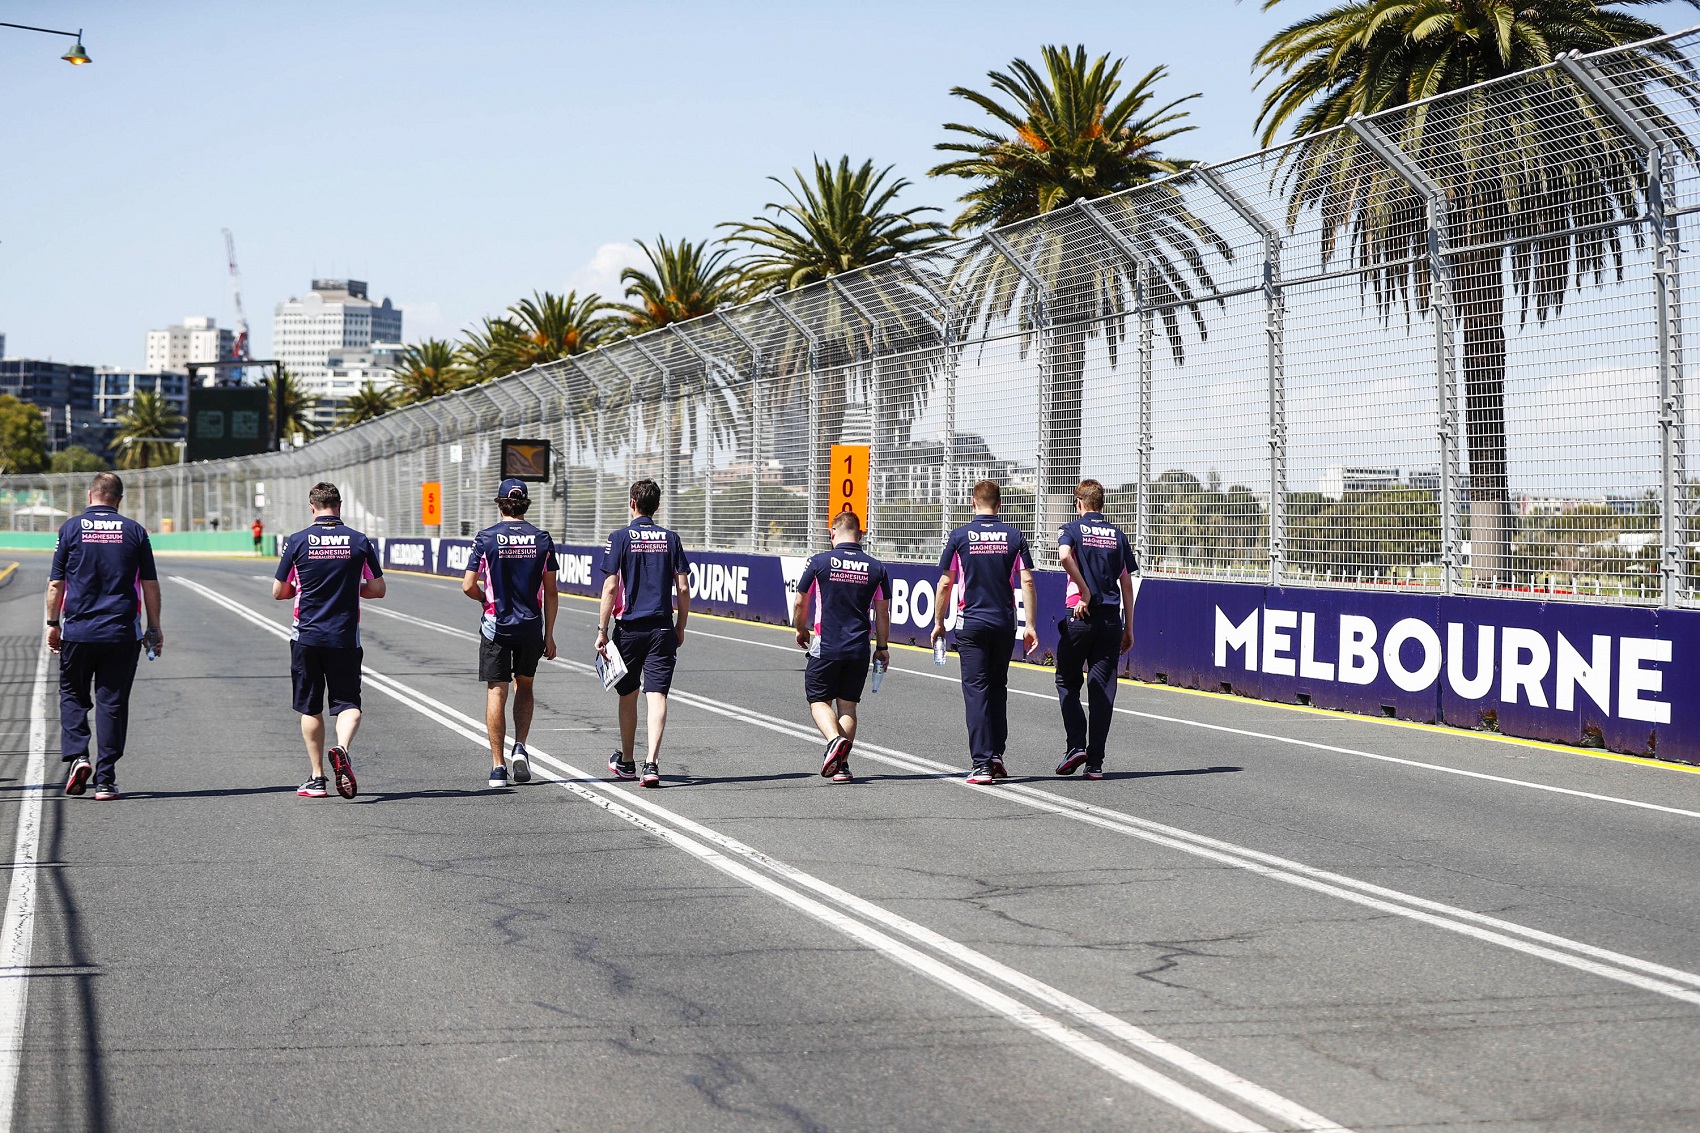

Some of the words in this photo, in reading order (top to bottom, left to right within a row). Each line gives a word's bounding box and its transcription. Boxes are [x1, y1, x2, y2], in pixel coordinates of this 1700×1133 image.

[94, 520, 123, 530] BWT
[640, 531, 667, 540] BWT
[980, 531, 1007, 541] BWT
[1091, 526, 1116, 537] BWT
[321, 535, 350, 546] BWT
[508, 535, 536, 545] BWT
[1082, 537, 1117, 546] MAGNESIUM
[842, 559, 869, 572] BWT
[830, 572, 868, 581] MAGNESIUM
[1214, 605, 1673, 725] MELBOURNE
